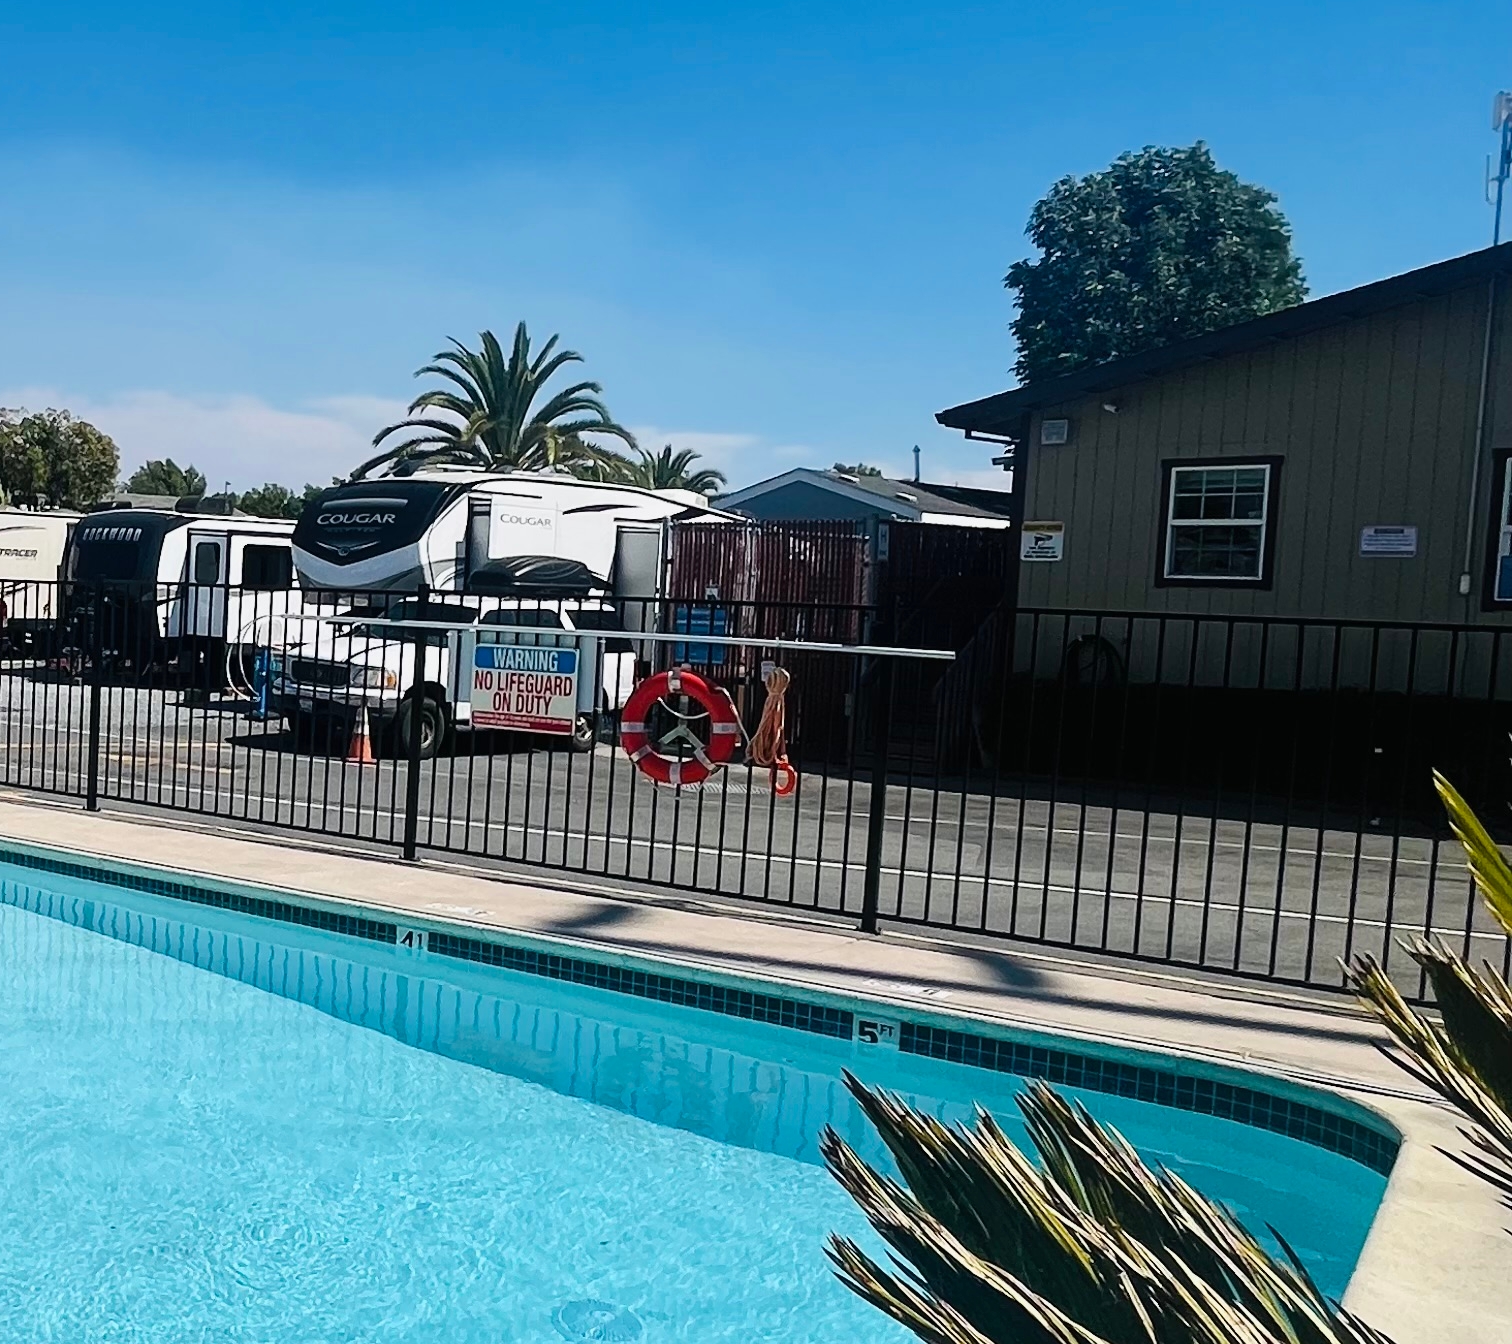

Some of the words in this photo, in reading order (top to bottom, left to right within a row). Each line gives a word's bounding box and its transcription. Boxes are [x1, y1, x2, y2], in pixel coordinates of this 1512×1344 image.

[316, 513, 397, 525] COUGAR
[500, 513, 552, 527] COUGAR
[82, 527, 143, 542] ROCKWOOD
[493, 648, 559, 671] WARNING
[474, 670, 493, 690] NO
[497, 672, 573, 696] LIFEGUARD
[493, 692, 511, 712] ON
[516, 694, 553, 715] DUTY
[858, 1020, 879, 1044] 5
